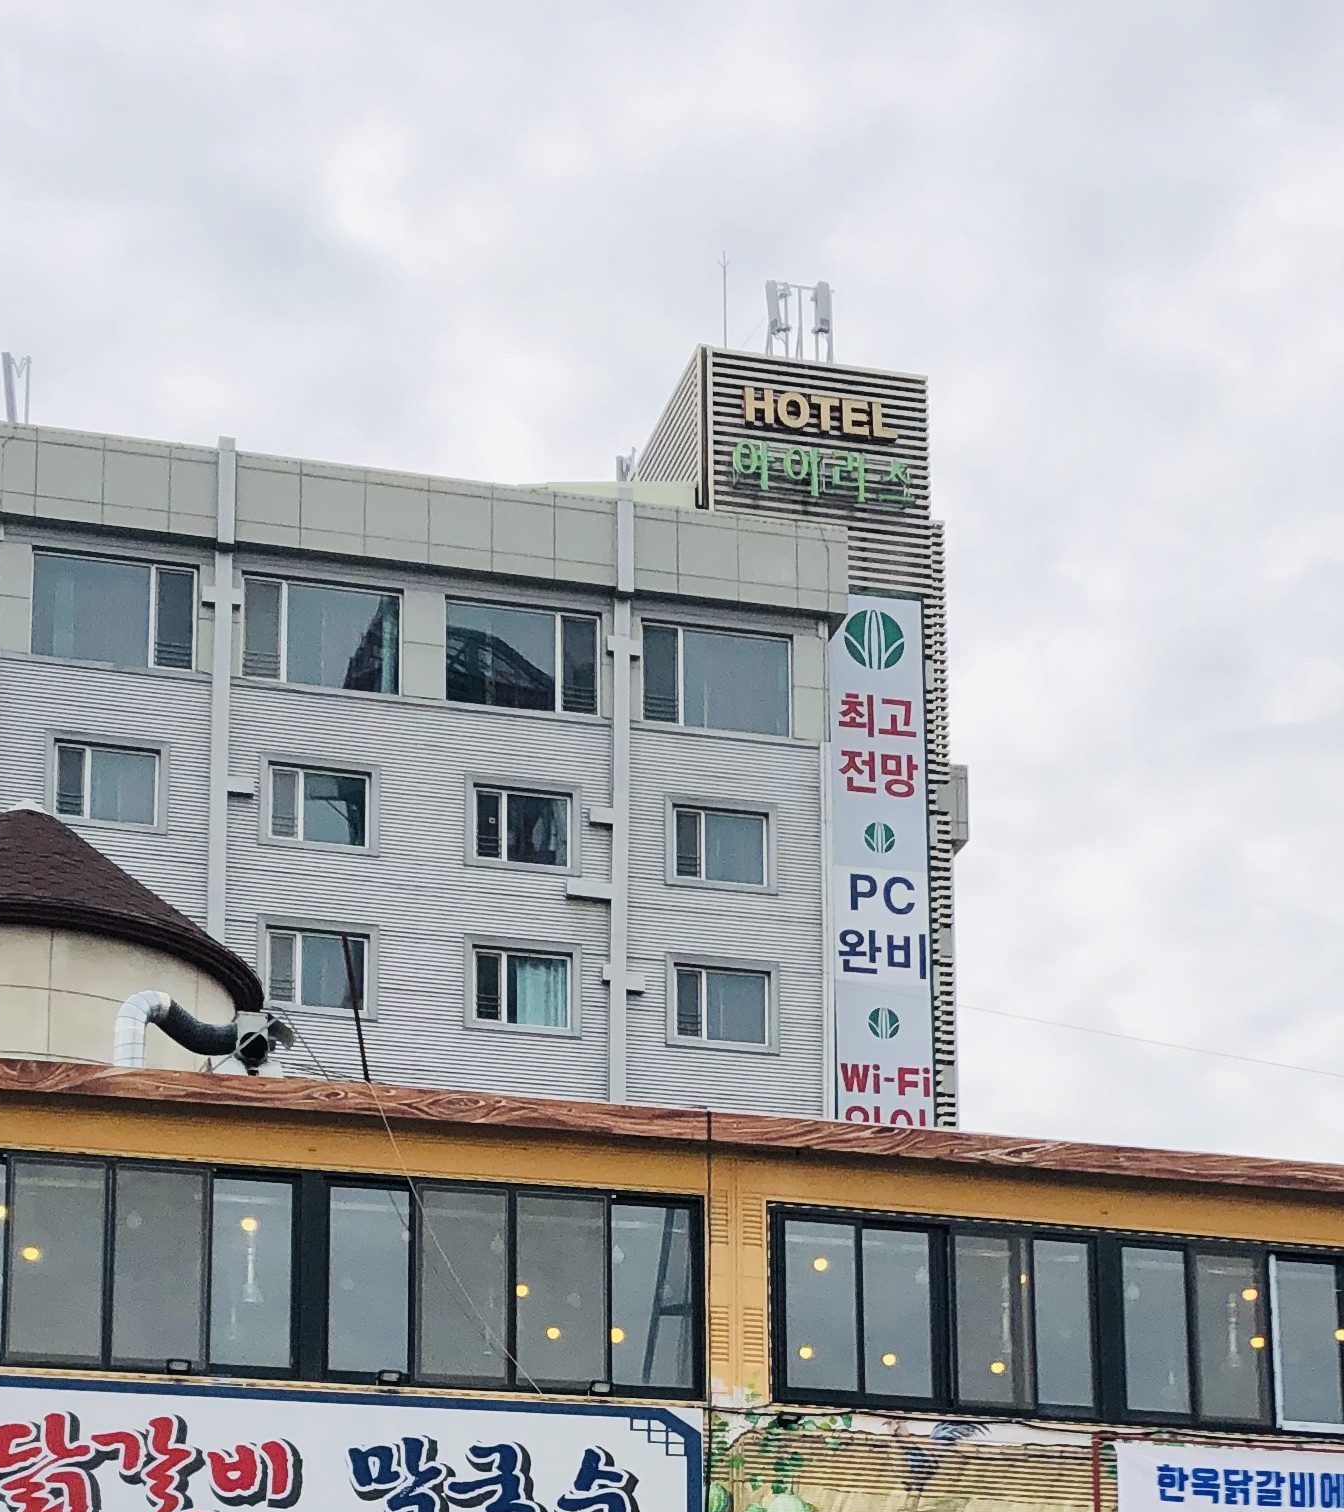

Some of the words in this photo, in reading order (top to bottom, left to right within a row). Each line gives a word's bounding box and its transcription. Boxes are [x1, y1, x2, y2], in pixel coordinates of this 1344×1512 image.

[743, 385, 899, 440] HOTEL
[839, 692, 917, 738] 최고
[839, 750, 918, 798] 전망
[849, 873, 916, 915] PC
[838, 929, 927, 980] 완비
[840, 1062, 931, 1098] Wi-Fi
